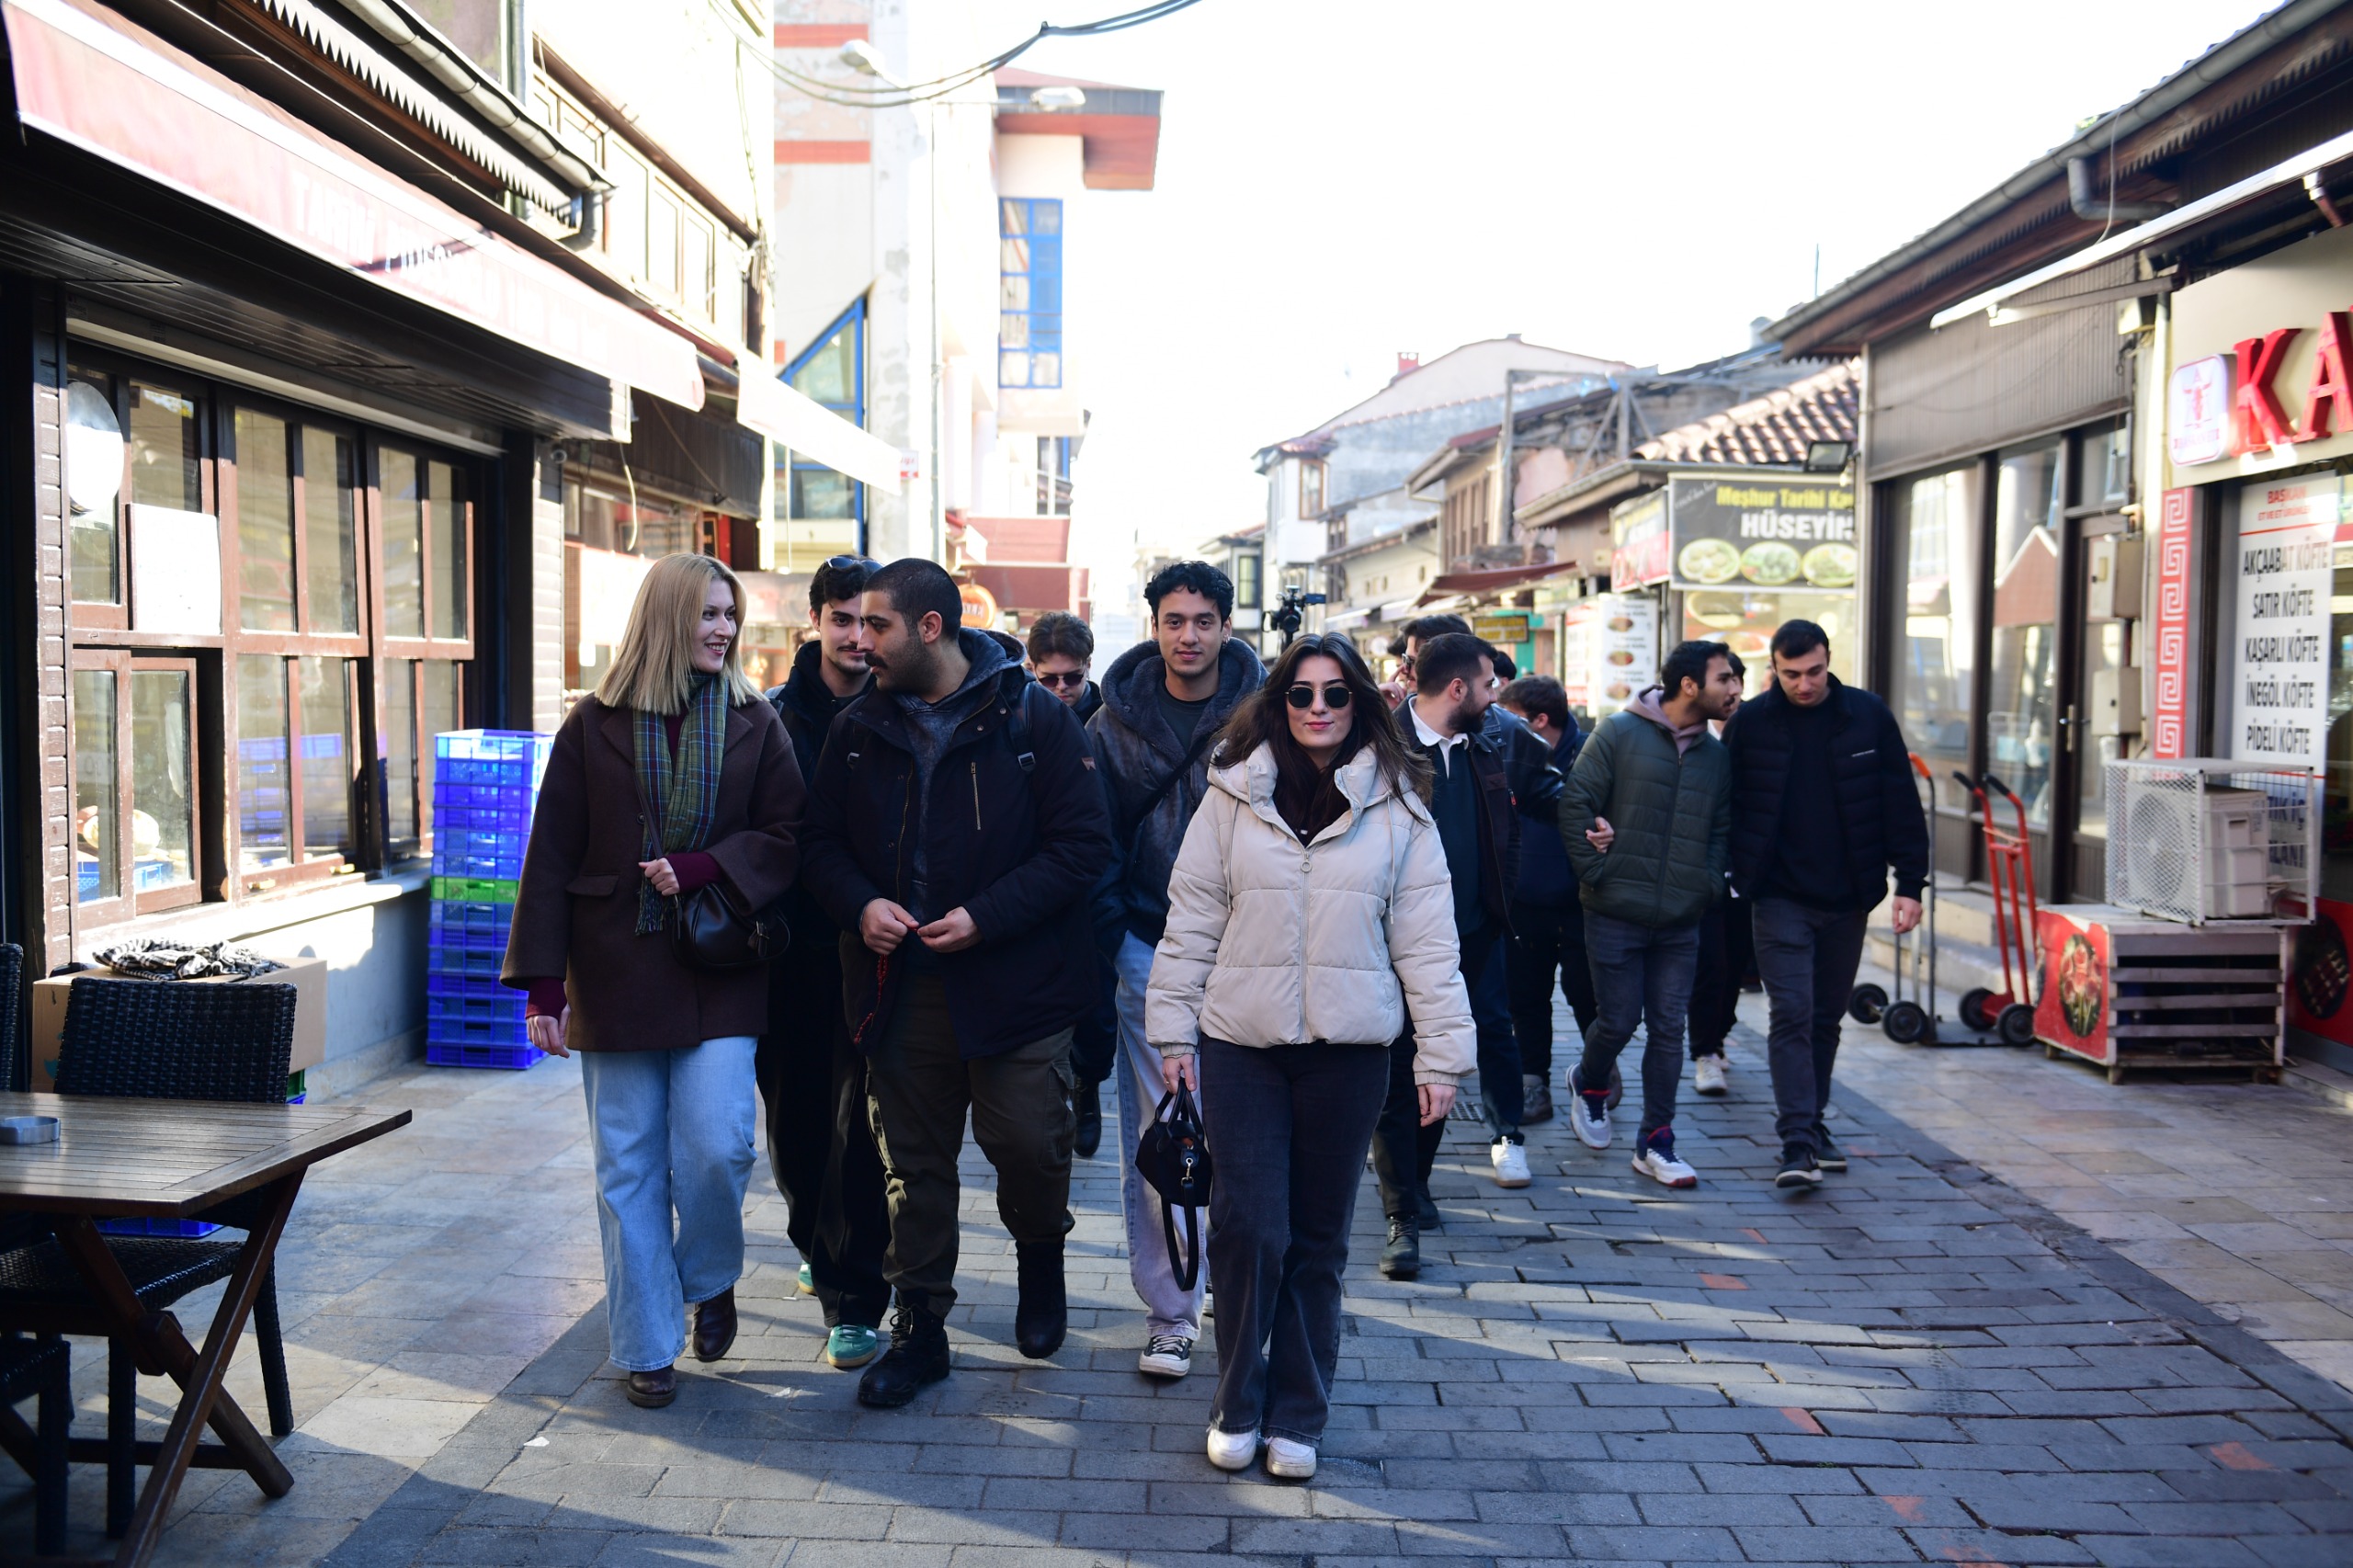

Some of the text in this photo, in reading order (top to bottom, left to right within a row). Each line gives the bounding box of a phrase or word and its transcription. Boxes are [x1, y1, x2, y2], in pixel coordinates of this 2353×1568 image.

[2231, 306, 2353, 458] KA
[1716, 485, 1777, 508] Meşhur
[1779, 488, 1826, 509] Tarihi
[1740, 509, 1853, 540] HÜSEYİN
[2244, 536, 2328, 582] AKÇAABAT KÖFTE
[2253, 583, 2313, 619] SATIR KÖFTE
[2245, 629, 2319, 670] KAŞARLI KÖFTE
[2245, 674, 2314, 709] İNEGÖL KÖFTE
[2247, 719, 2311, 755] PİDELİ KÖFTE
[2268, 796, 2288, 822] TIK
